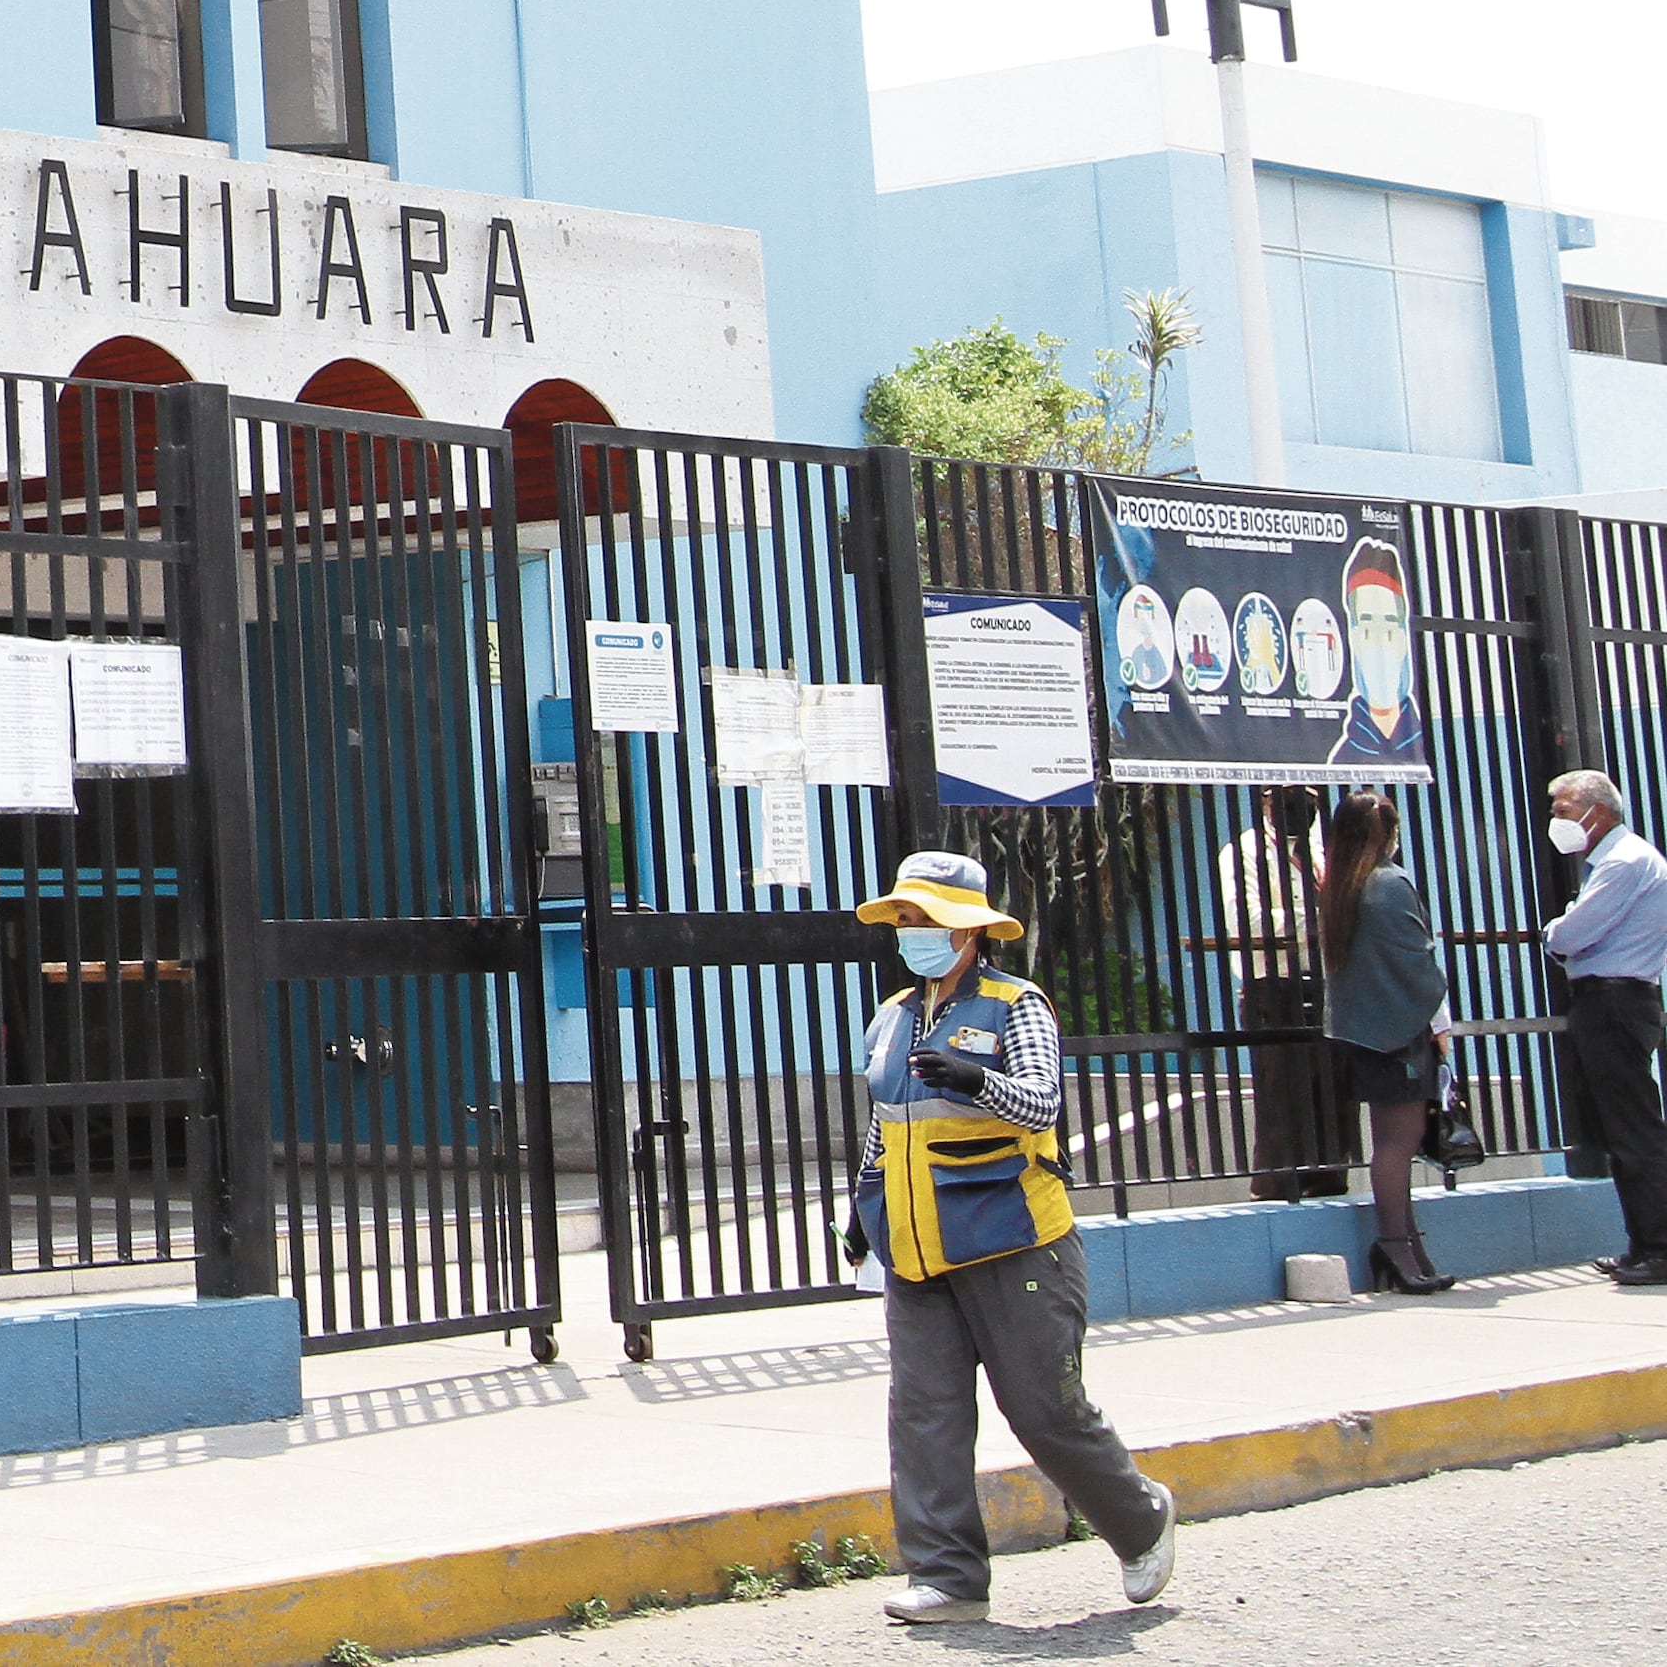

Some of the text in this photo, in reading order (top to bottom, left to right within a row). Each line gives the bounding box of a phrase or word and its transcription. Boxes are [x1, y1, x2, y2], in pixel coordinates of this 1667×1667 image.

[1118, 498, 1346, 541] PROTOCOLOS DE BIOSEGURIDAD
[970, 616, 1032, 632] COMUNICADO
[102, 664, 153, 674] COMUNICADO
